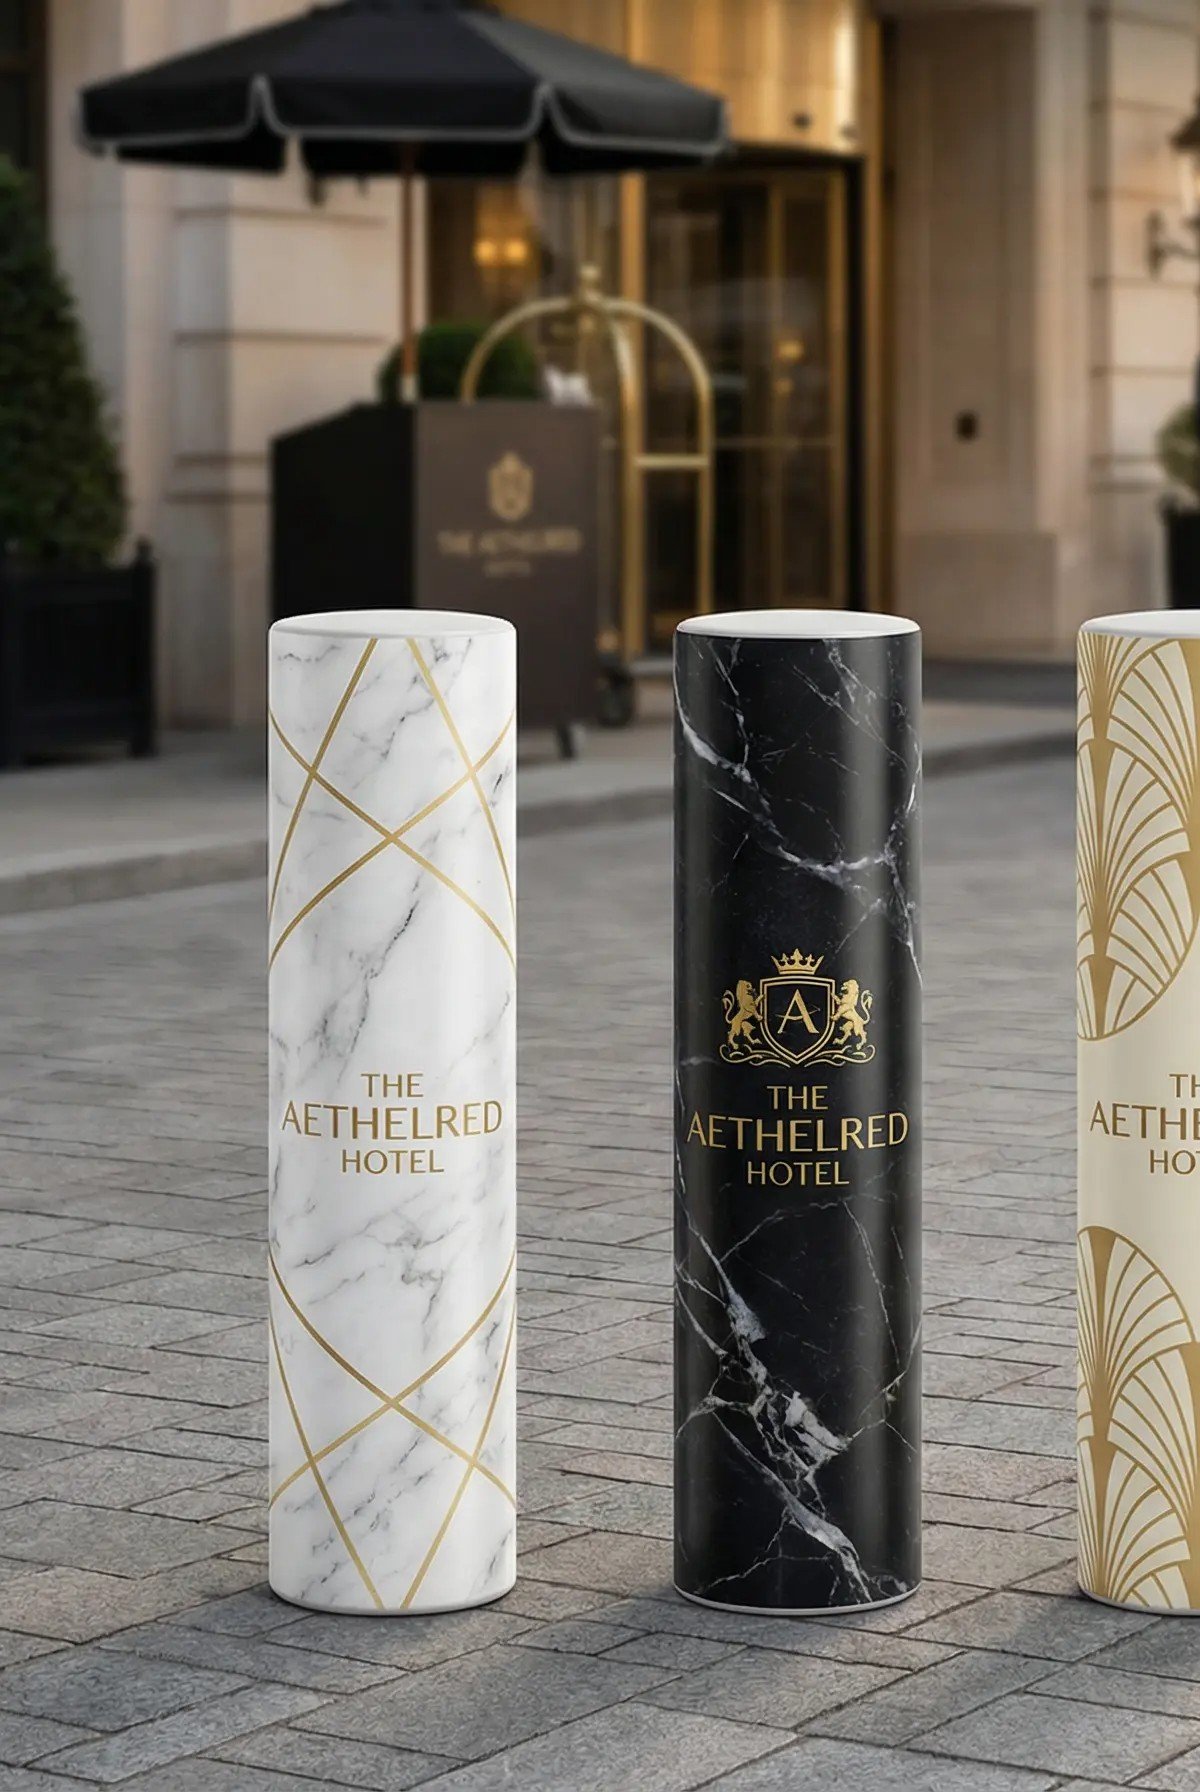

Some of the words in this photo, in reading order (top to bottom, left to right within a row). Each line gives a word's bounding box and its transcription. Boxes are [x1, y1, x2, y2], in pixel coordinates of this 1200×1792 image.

[775, 988, 821, 1034] A
[360, 1073, 424, 1098] THE
[766, 1085, 828, 1111] THE
[282, 1100, 503, 1140] AETHELRED
[686, 1111, 908, 1152] AETHELRED
[340, 1149, 445, 1175] HOTEL
[746, 1161, 850, 1186] HOTEL
